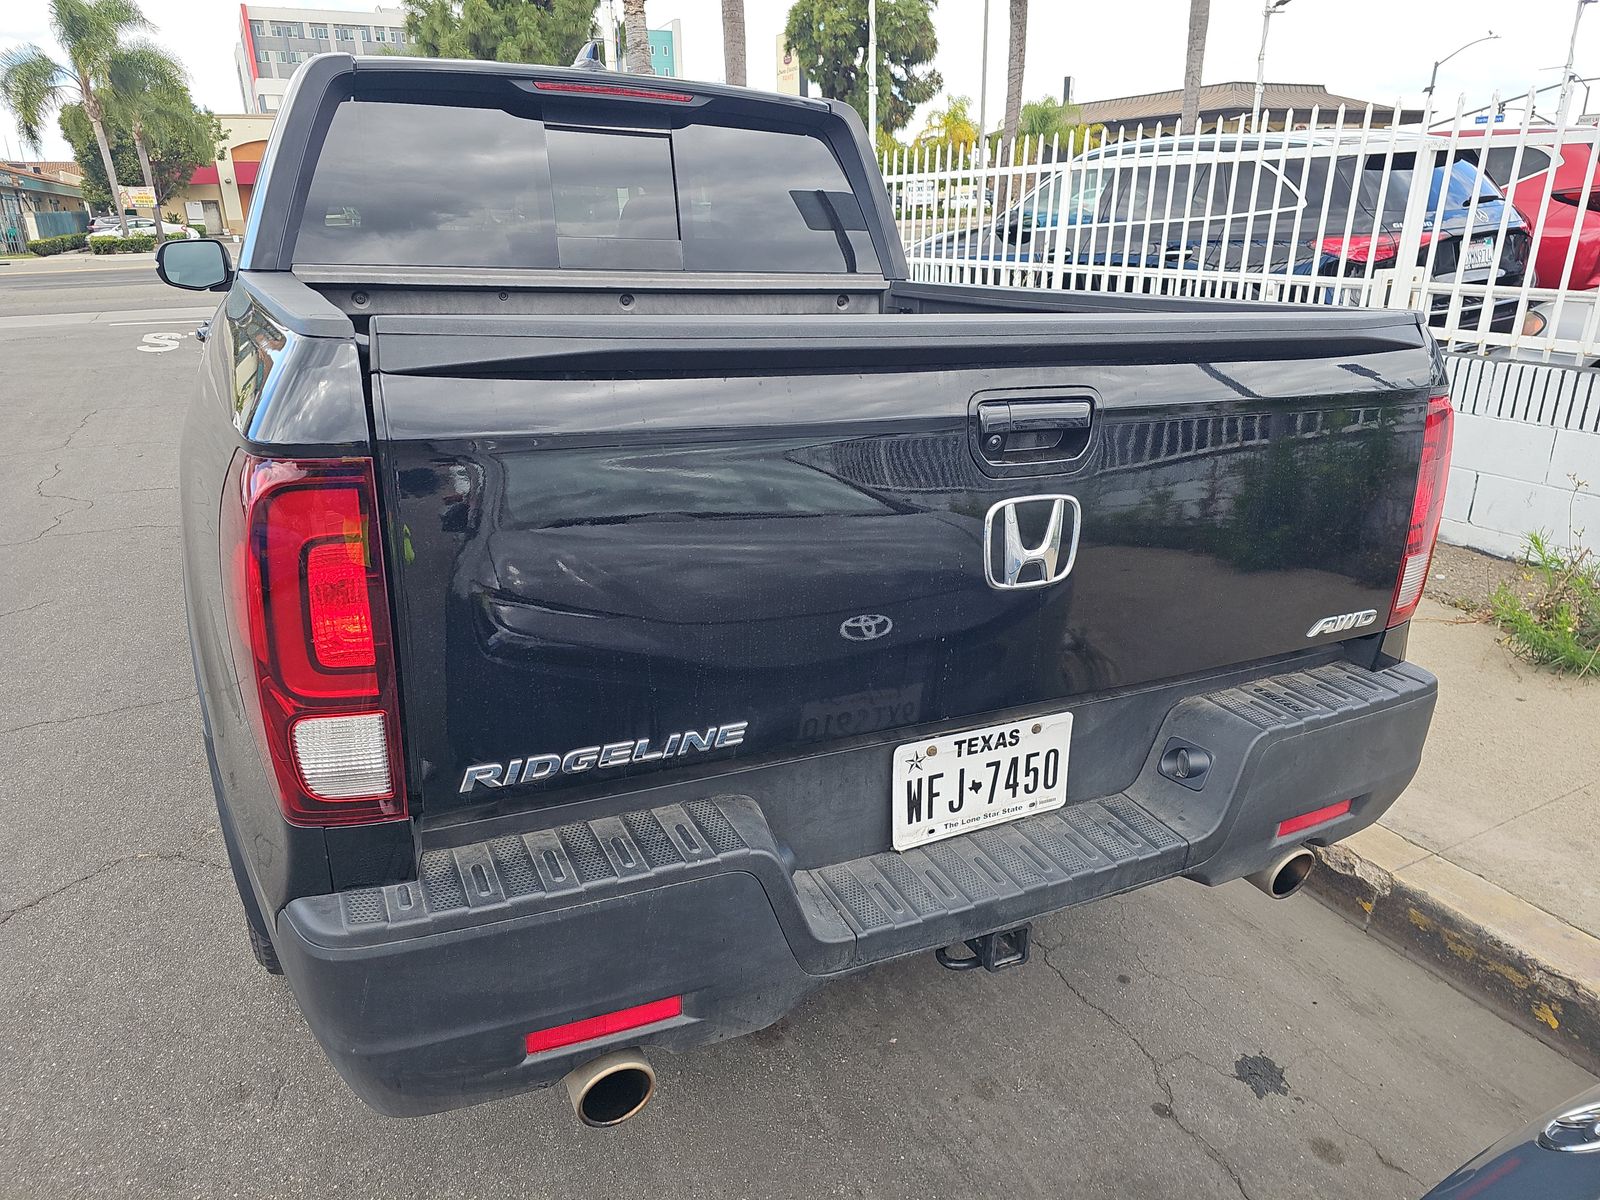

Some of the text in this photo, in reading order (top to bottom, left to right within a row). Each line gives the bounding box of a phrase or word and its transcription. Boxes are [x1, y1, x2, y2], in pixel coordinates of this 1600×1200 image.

[1306, 609, 1378, 638] AWD
[459, 722, 748, 792] RIDGELINE
[954, 729, 1020, 758] TEXAS
[907, 748, 1060, 825] WFJ 7450
[944, 804, 1023, 830] The Lone Star State
